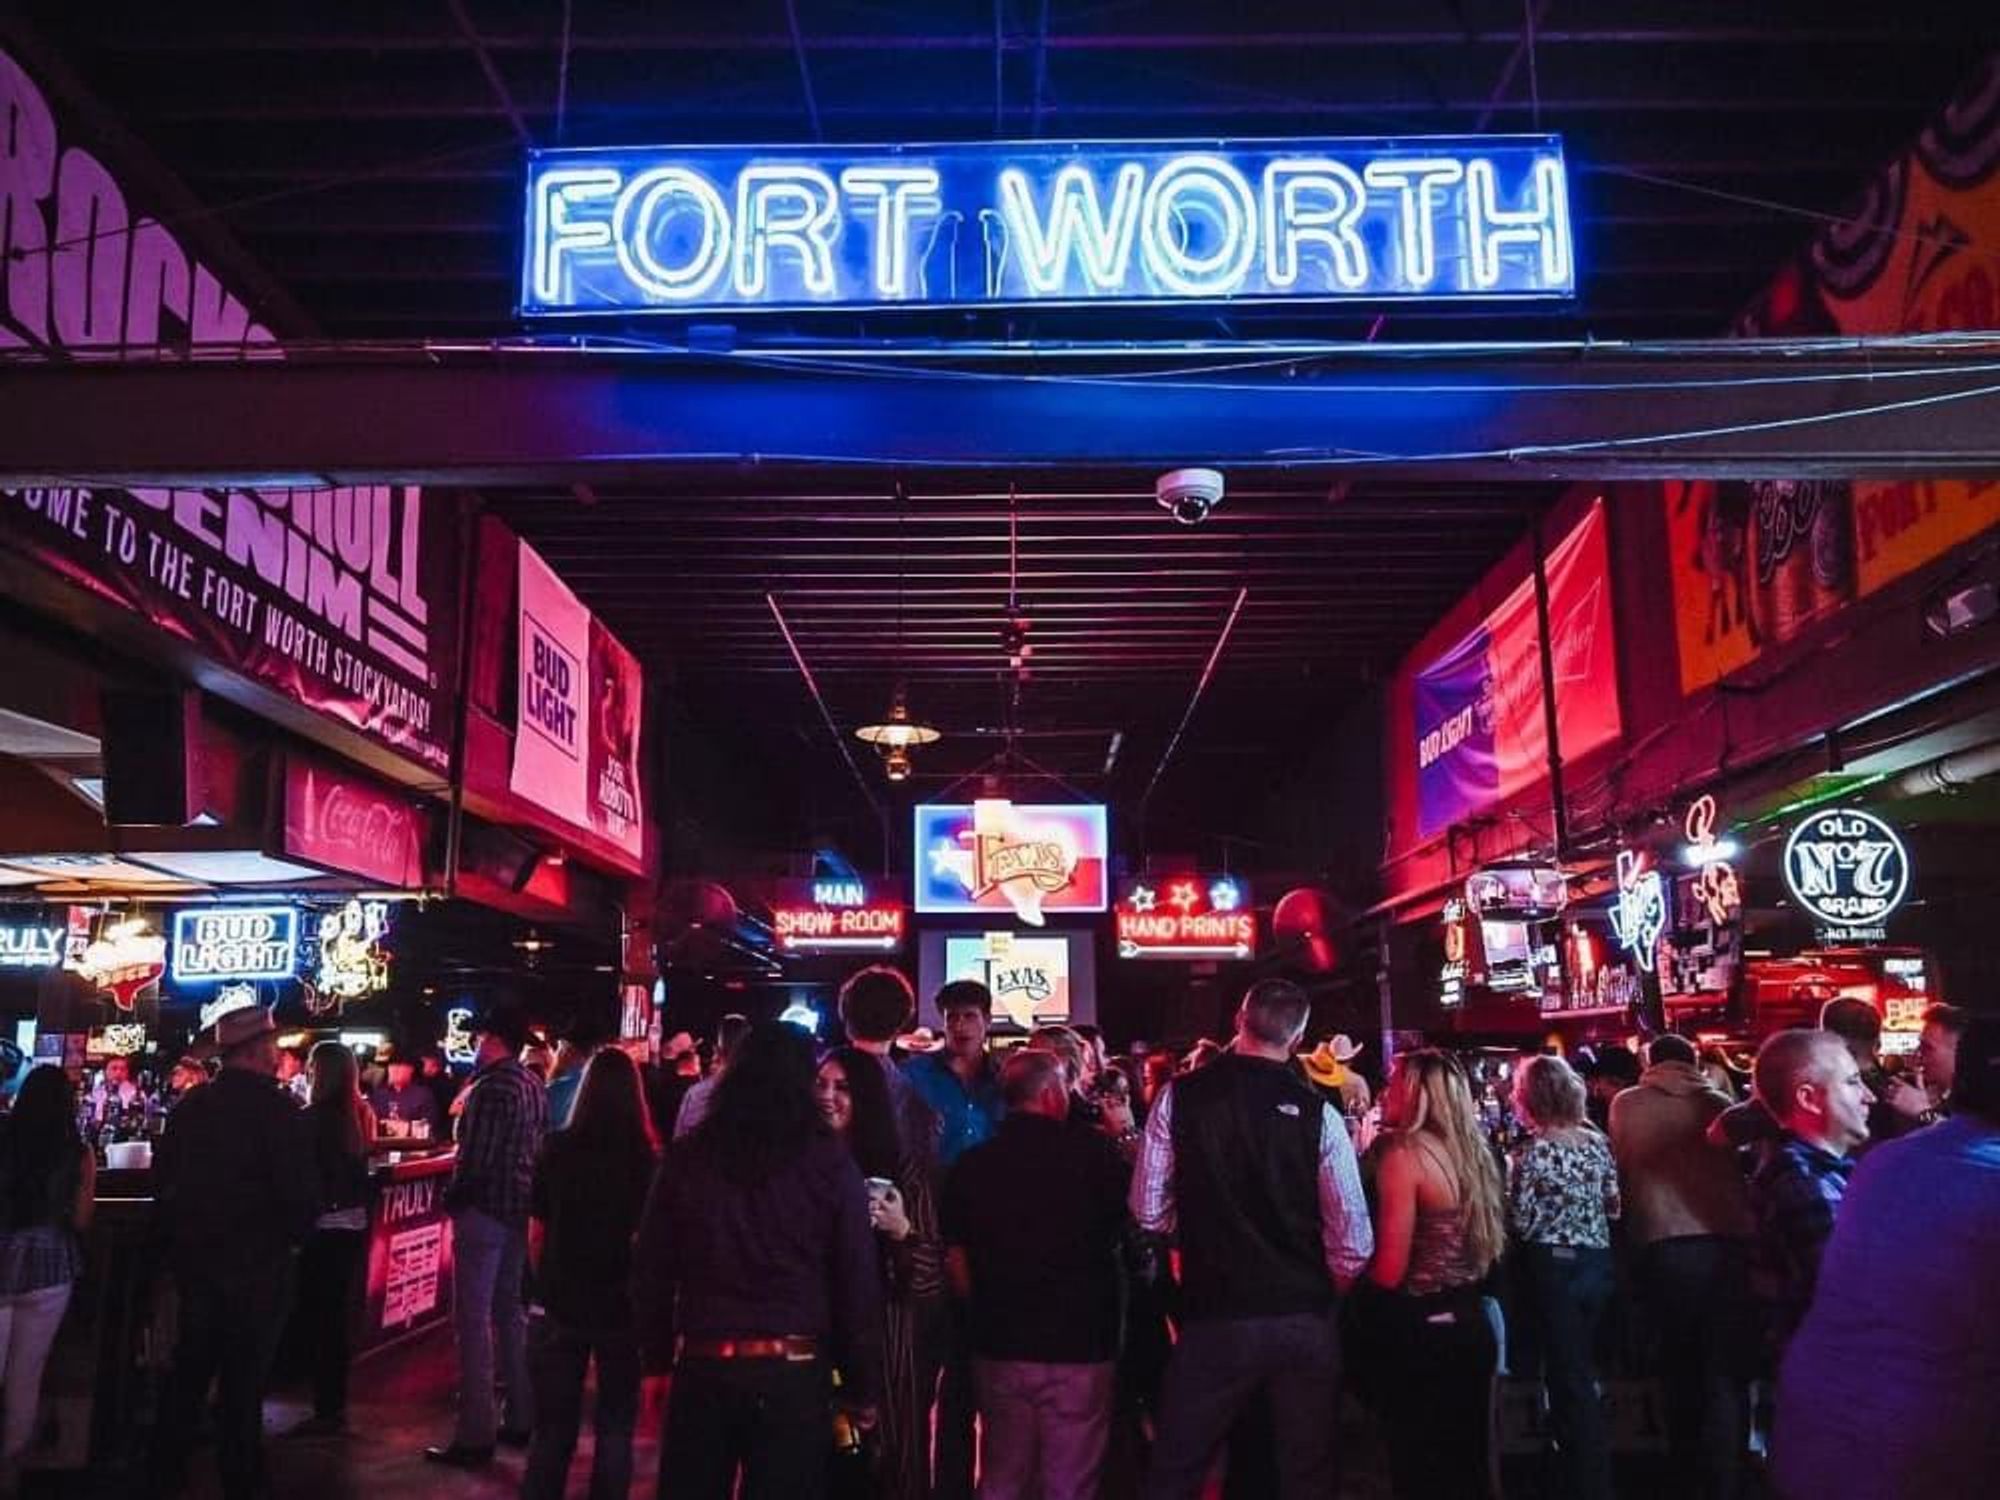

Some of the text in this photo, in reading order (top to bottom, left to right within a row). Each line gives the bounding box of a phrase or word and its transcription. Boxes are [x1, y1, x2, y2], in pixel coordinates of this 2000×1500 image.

[534, 155, 1569, 300] FORT WORTH
[104, 503, 136, 564] TO
[149, 531, 193, 600] THE
[202, 566, 258, 635] FORT
[264, 602, 328, 676] WORTH
[333, 646, 431, 733] STOCKYARDS!
[532, 633, 570, 699] BUD
[526, 671, 578, 746] LIGHT
[1818, 817, 1868, 837] OLD
[815, 883, 864, 906] MAIN
[197, 914, 275, 944] BUD
[775, 909, 900, 936] SHOW ROOM
[1119, 913, 1254, 941] HAND PRINTS
[179, 944, 289, 973] LIGHT
